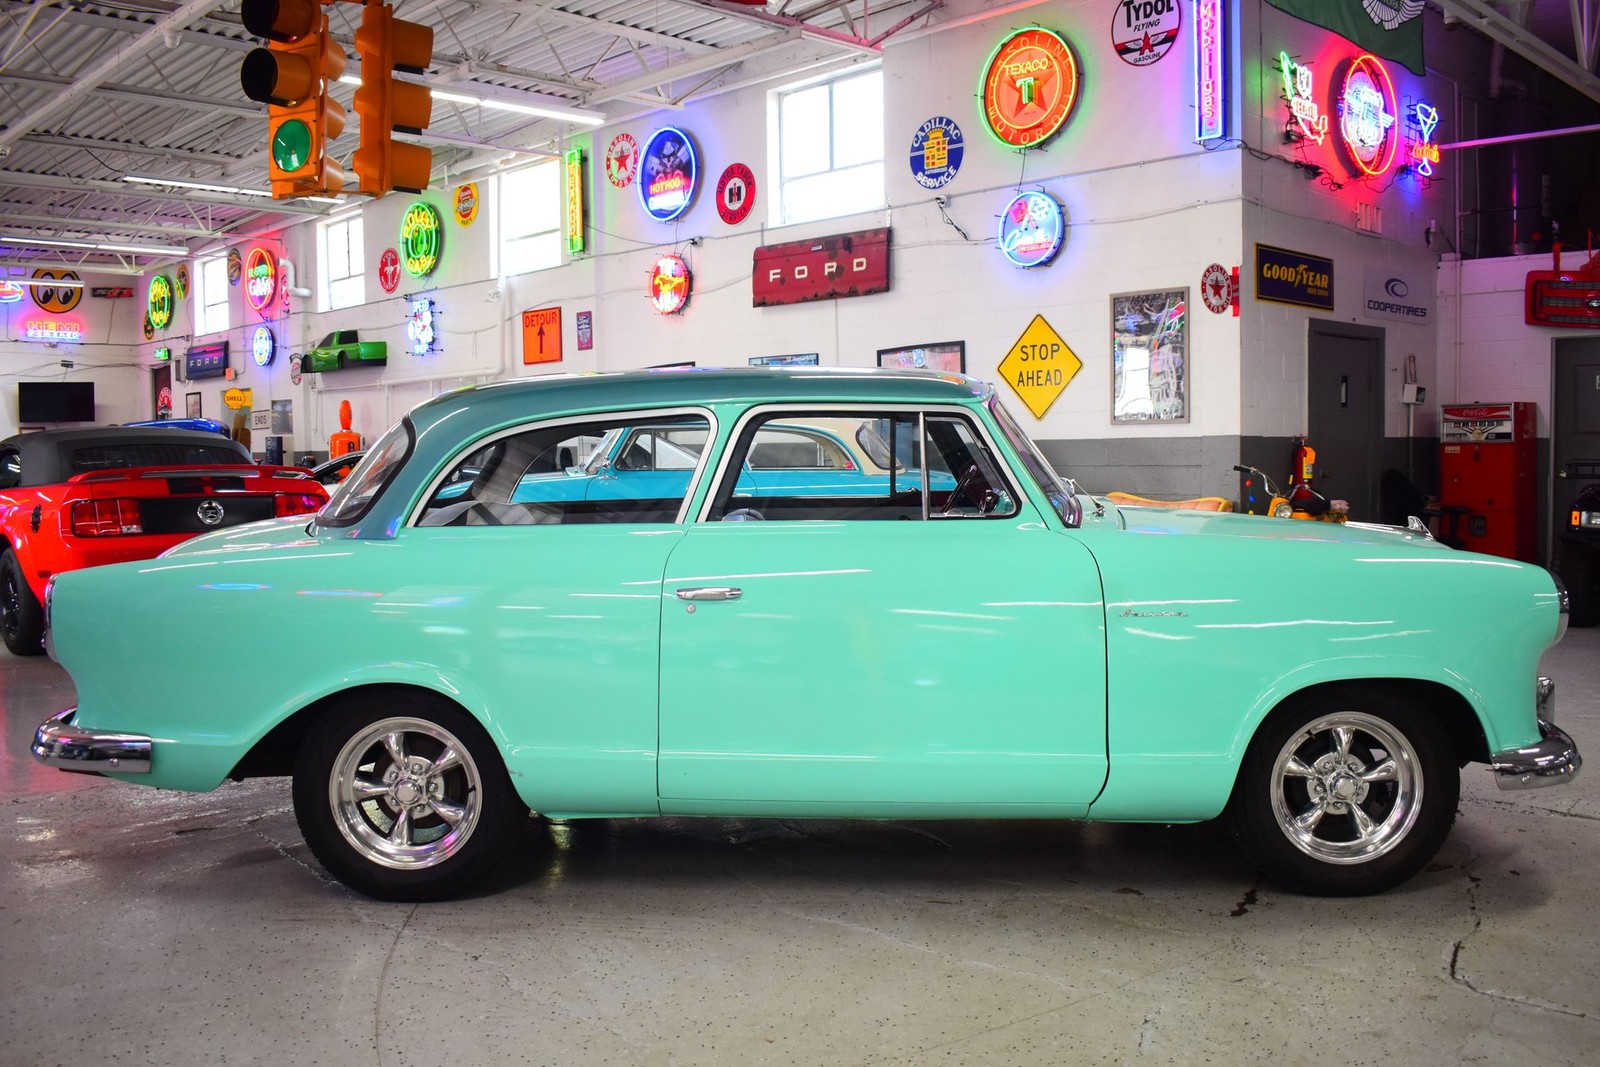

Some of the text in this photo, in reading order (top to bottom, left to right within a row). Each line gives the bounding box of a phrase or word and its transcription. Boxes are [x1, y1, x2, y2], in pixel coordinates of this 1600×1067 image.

[1123, 0, 1174, 28] TYDOL
[1133, 19, 1161, 32] FLYING
[990, 34, 1071, 87] GASOLINE
[1004, 57, 1049, 76] TEXACO
[1133, 52, 1161, 64] GASOLINE
[989, 92, 1072, 145] MOTOR OIL
[913, 117, 960, 147] CADILLAC
[609, 134, 637, 155] GASOLINE
[609, 169, 629, 187] MOTOR
[718, 165, 752, 193] MOTOR TRUCK
[913, 165, 957, 188] SERVICE
[568, 163, 577, 236] TEXACO
[721, 207, 748, 222] SERVICE
[769, 257, 867, 282] FORD
[1203, 265, 1231, 285] GASOLINE
[1263, 262, 1329, 289] GOODYEAR
[1203, 292, 1223, 313] MOTOR
[27, 320, 80, 331] HEMI
[525, 312, 557, 328] DETOUR
[189, 356, 219, 368] FORD
[1020, 343, 1061, 362] STOP
[1016, 368, 1063, 388] AHEAD
[254, 414, 267, 426] ENDS
